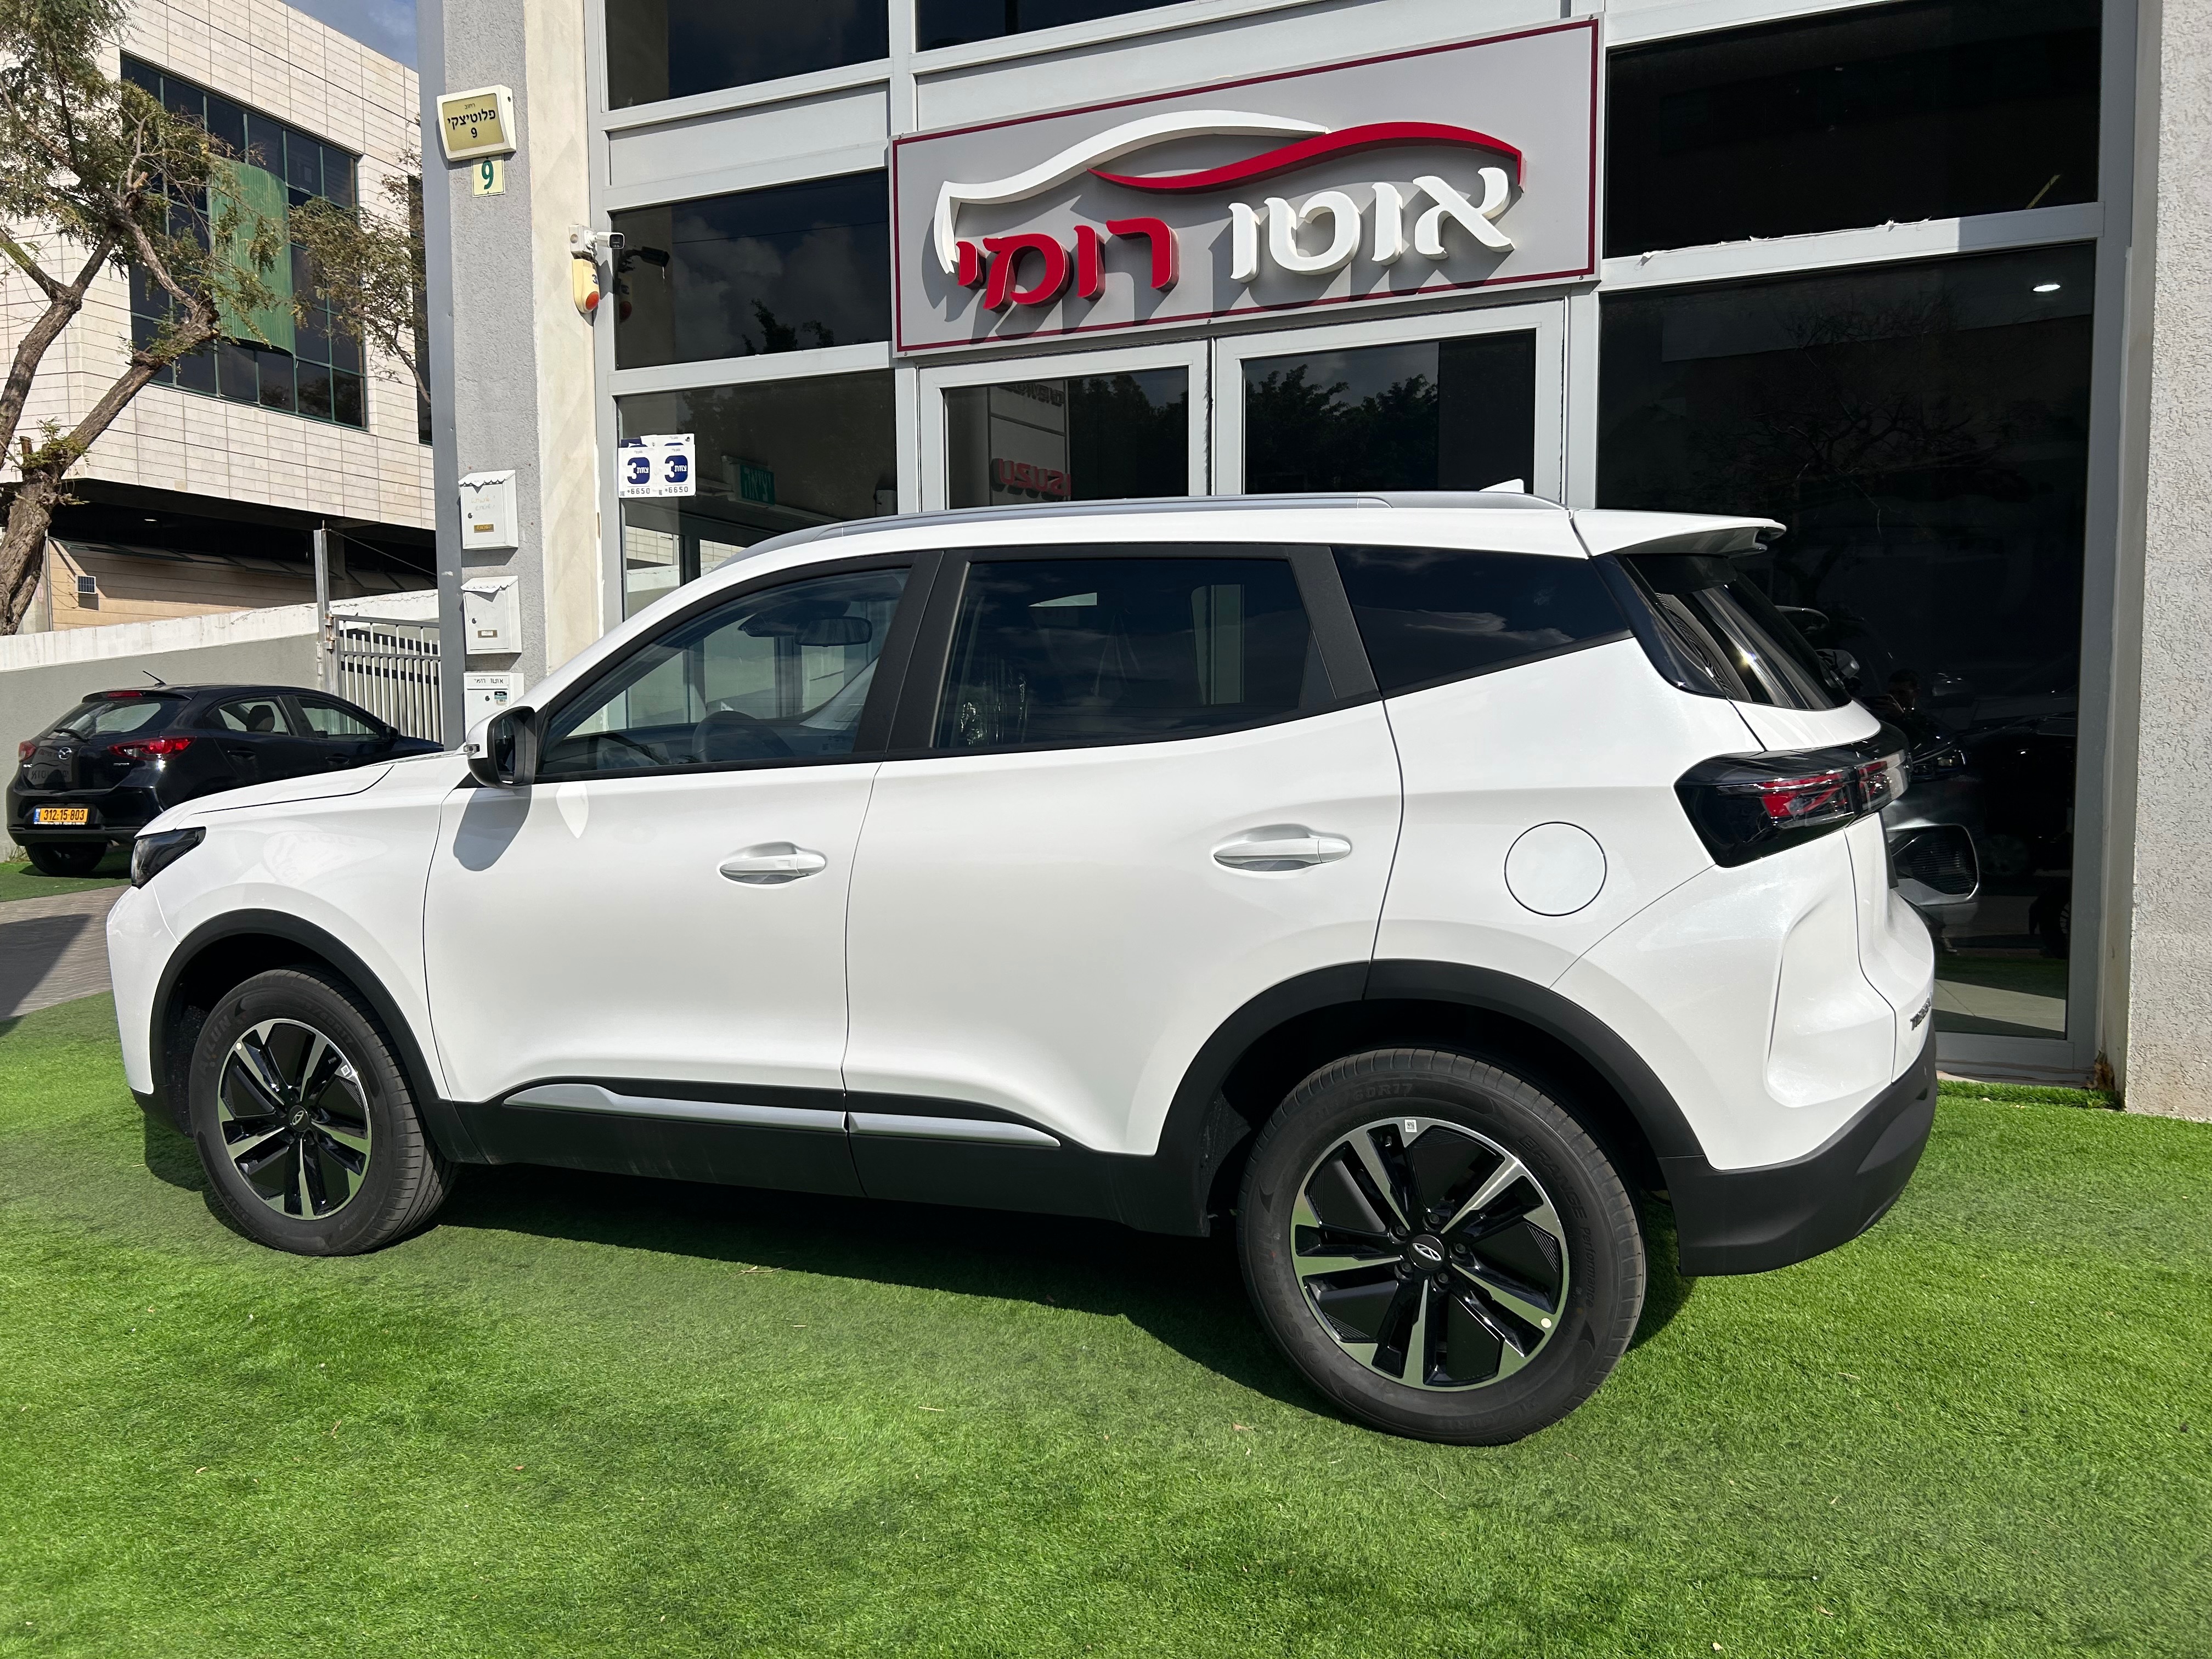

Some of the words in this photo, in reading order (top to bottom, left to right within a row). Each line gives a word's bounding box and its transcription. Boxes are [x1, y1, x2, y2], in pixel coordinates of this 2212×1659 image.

[447, 108, 496, 130] פלוטיצקי
[471, 127, 478, 138] 9
[481, 160, 494, 190] 9
[1228, 167, 1515, 284] אוטו
[955, 217, 1180, 313] רומי
[1516, 1133, 1588, 1220] ERANGE
[1579, 1226, 1597, 1308] Performance
